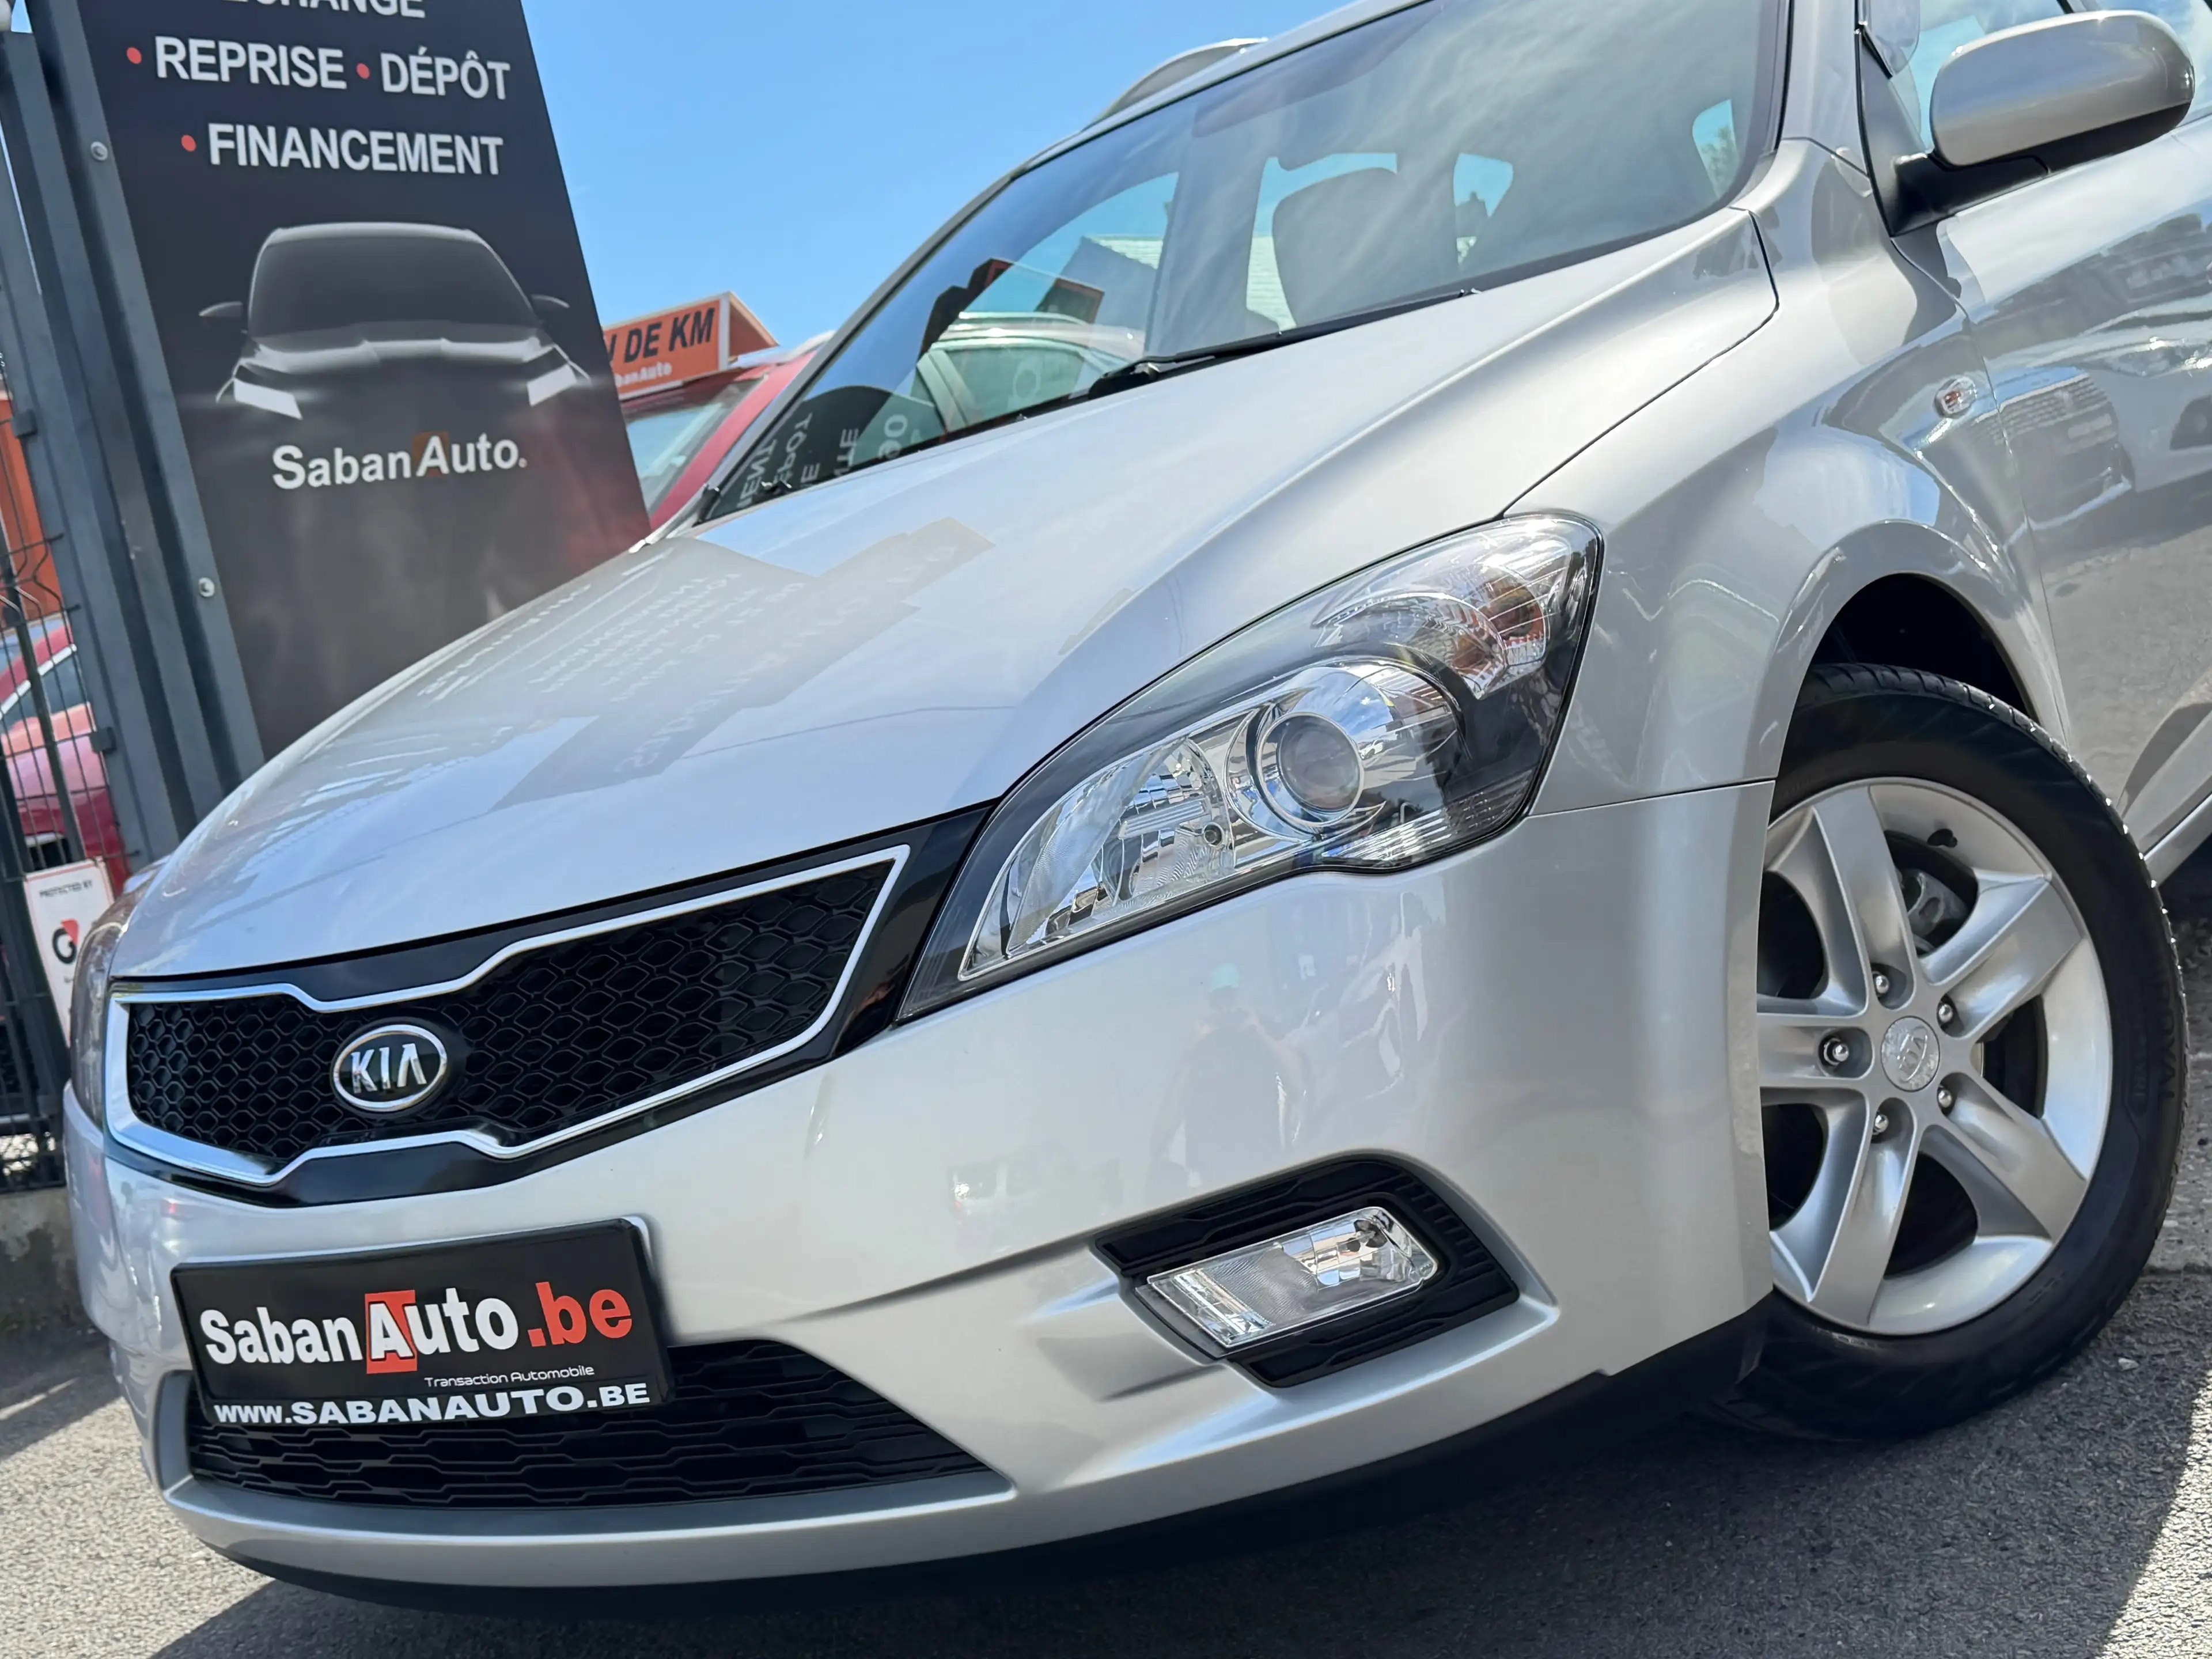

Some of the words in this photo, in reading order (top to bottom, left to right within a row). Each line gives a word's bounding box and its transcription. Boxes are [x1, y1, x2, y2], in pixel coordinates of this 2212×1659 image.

[155, 36, 347, 89] REPRISE
[380, 46, 510, 100] DÉPÔT
[208, 123, 503, 175] FINANCEMENT
[624, 322, 661, 363] DE
[669, 308, 715, 351] KM
[351, 1043, 427, 1093] KIA
[425, 1373, 508, 1388] Transaction
[511, 1365, 595, 1382] Automobile
[214, 1382, 650, 1425] WWW.SABANAUTO.BE
